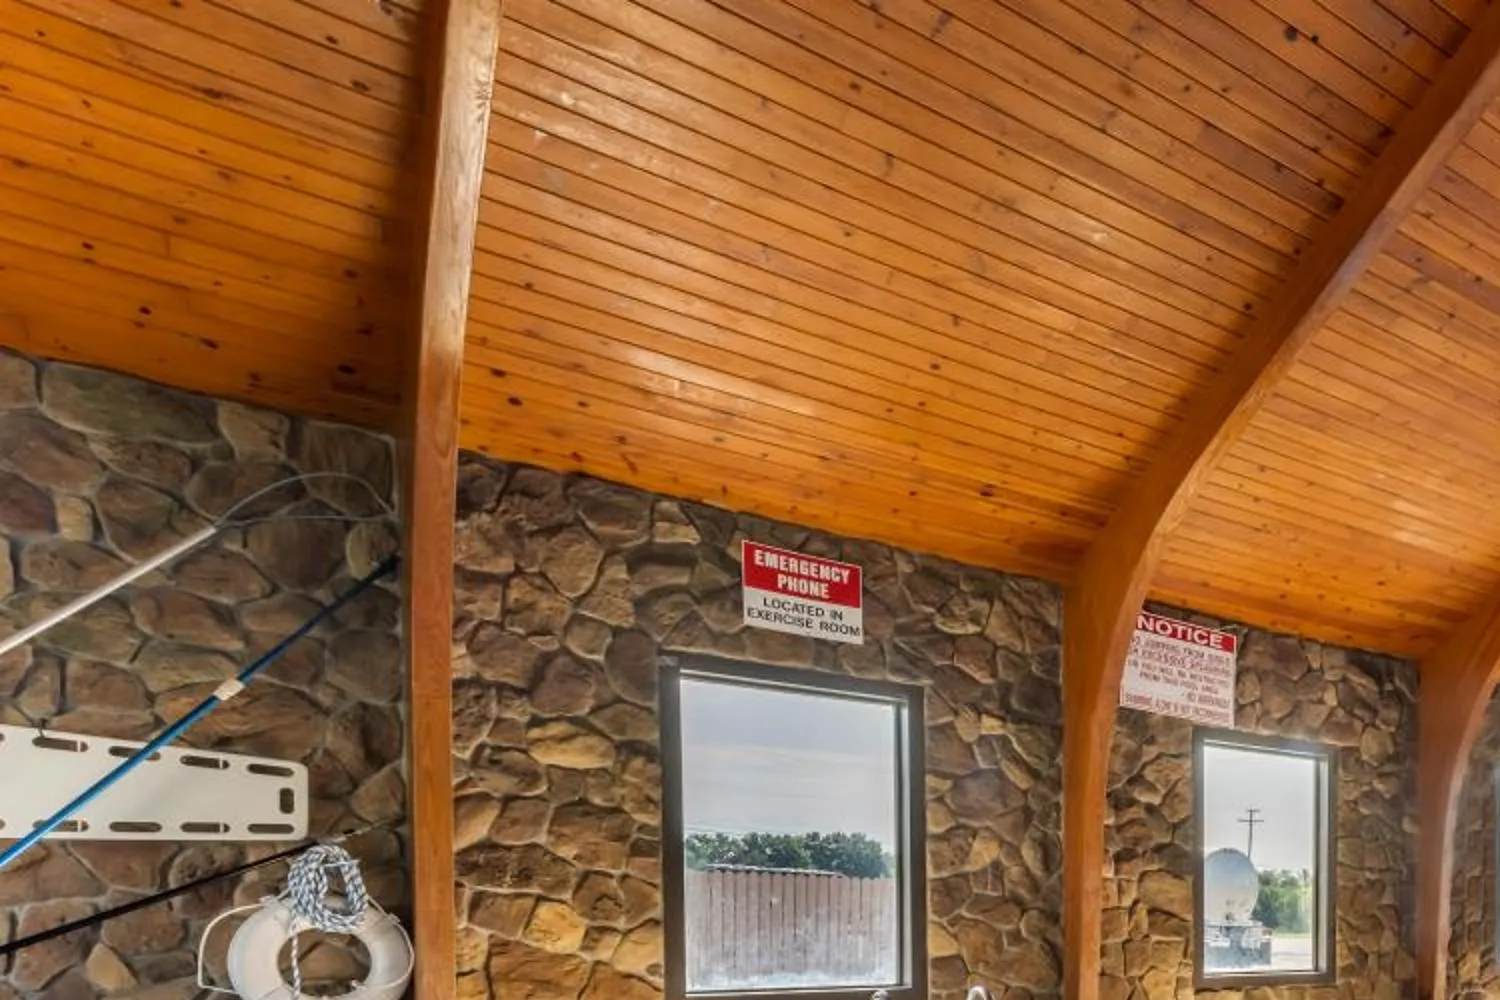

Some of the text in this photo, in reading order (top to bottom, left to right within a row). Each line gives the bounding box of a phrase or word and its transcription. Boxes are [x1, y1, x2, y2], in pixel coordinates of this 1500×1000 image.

[754, 549, 851, 585] EMERGENCY
[777, 573, 831, 599] PHONE
[747, 607, 861, 637] EXERCISE ROOM
[763, 597, 843, 621] LOCATED IN
[1137, 615, 1223, 649] NOTICE
